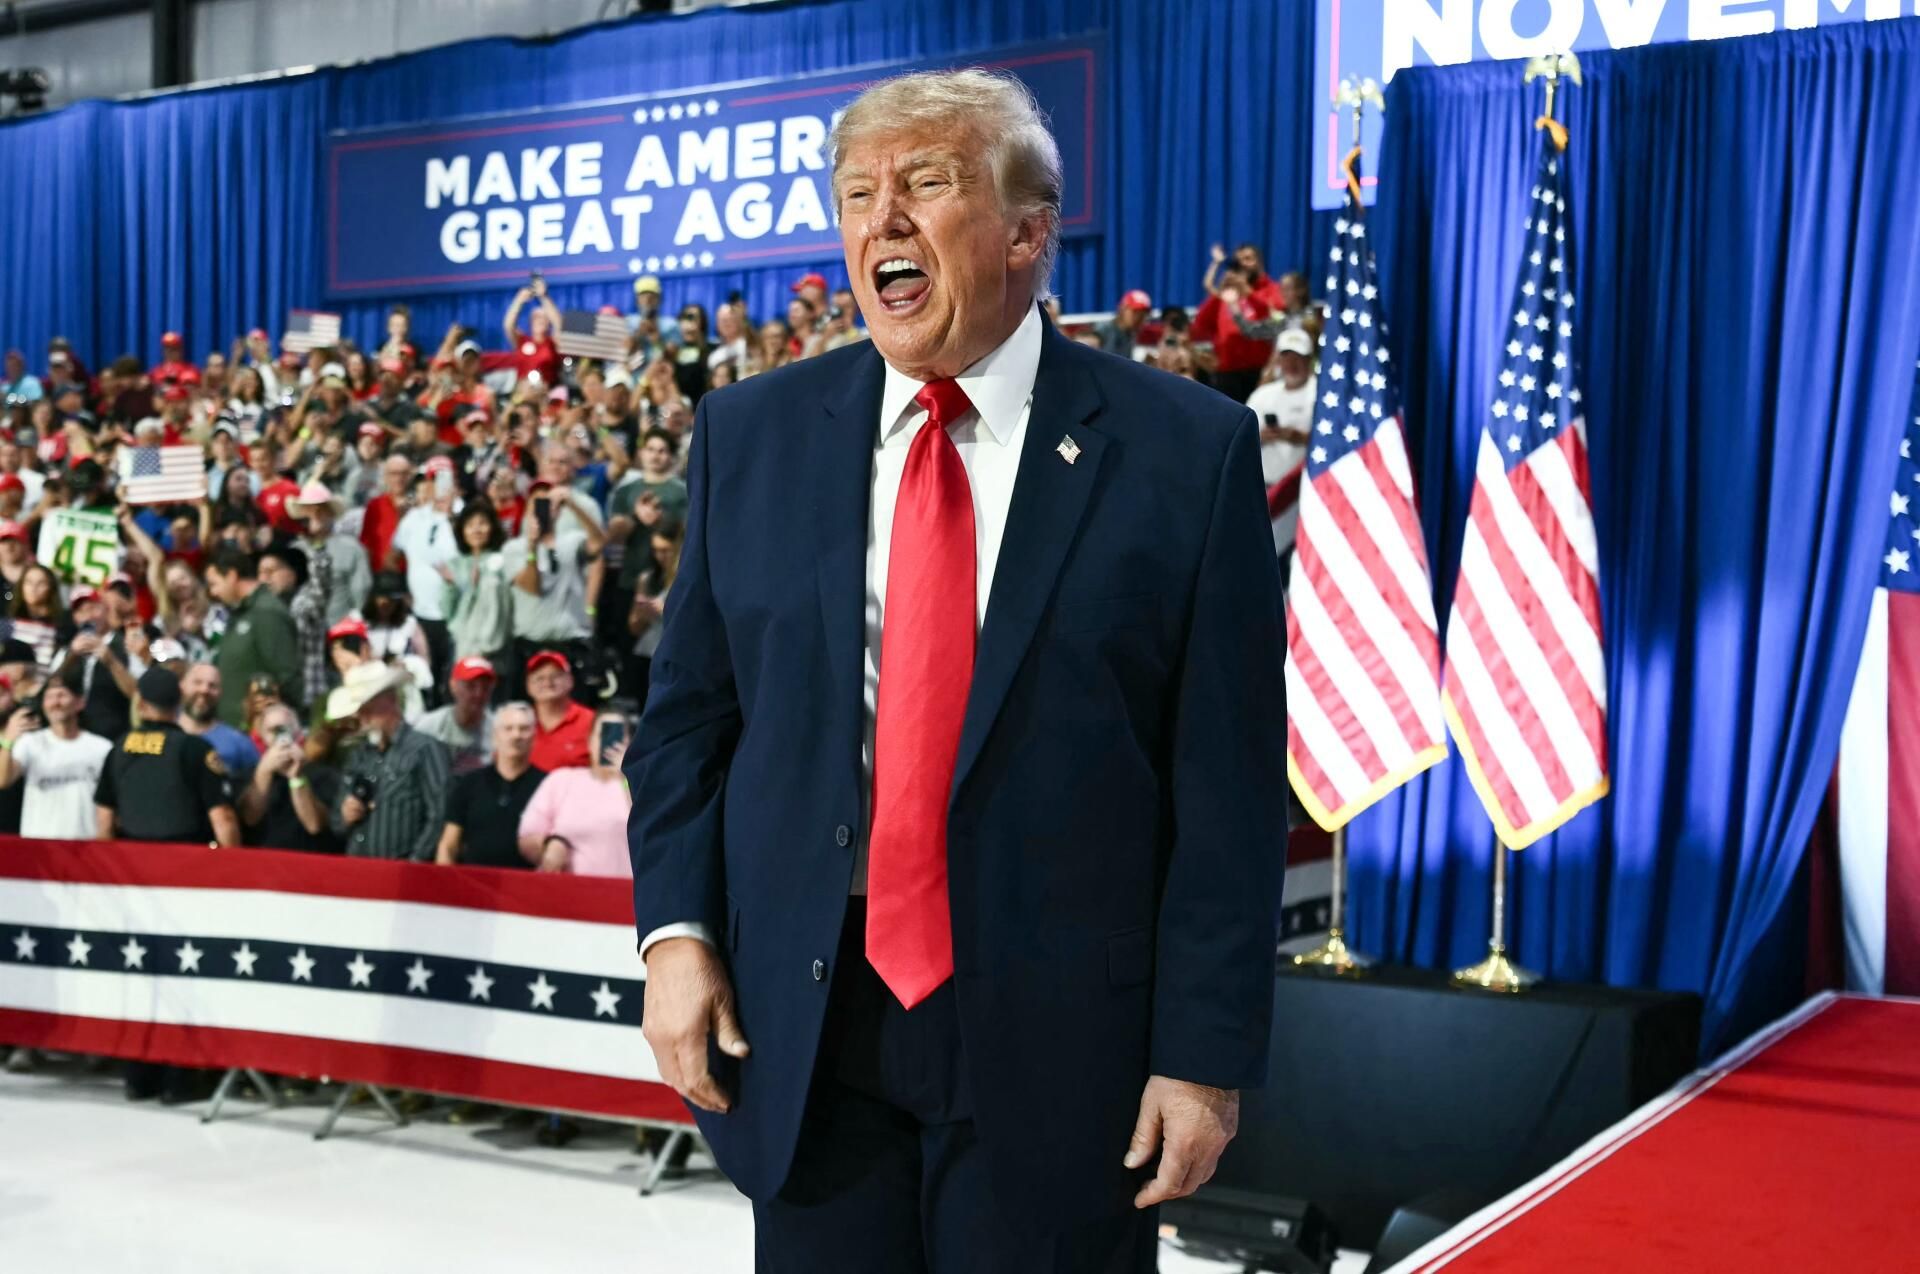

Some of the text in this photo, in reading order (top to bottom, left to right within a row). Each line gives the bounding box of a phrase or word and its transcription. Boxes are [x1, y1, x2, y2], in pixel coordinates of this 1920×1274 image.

[1382, 0, 1920, 84] NOV
[425, 112, 843, 209] MAKE AMER
[440, 176, 841, 263] GREAT AGA
[54, 535, 116, 588] 45
